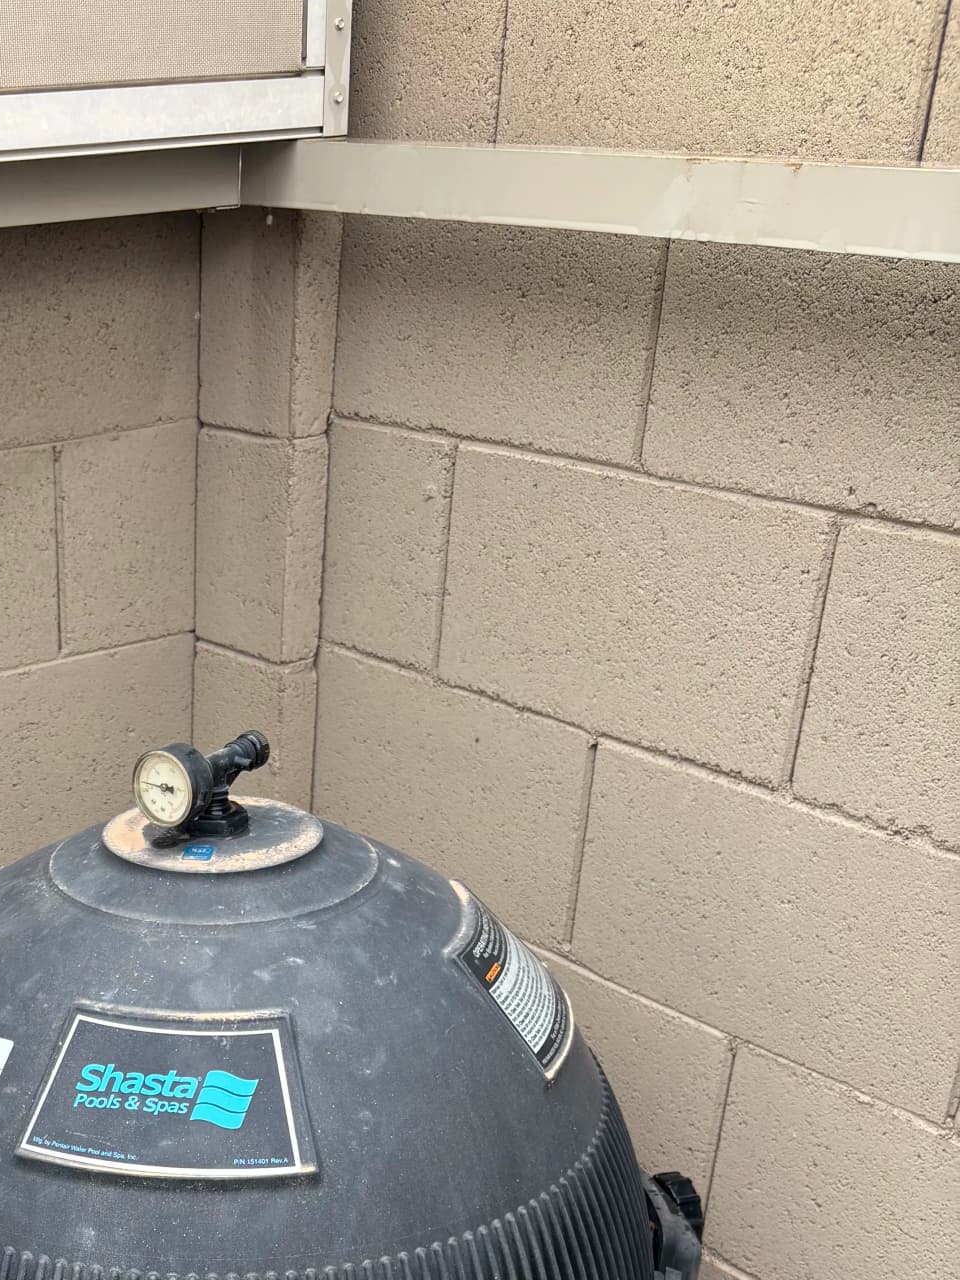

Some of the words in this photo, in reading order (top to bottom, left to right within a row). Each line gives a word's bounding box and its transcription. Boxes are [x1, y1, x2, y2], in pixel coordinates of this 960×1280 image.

[75, 1063, 199, 1099] Shasta
[73, 1094, 120, 1110] Pools
[124, 1096, 140, 1110] &
[143, 1097, 189, 1115] Spas
